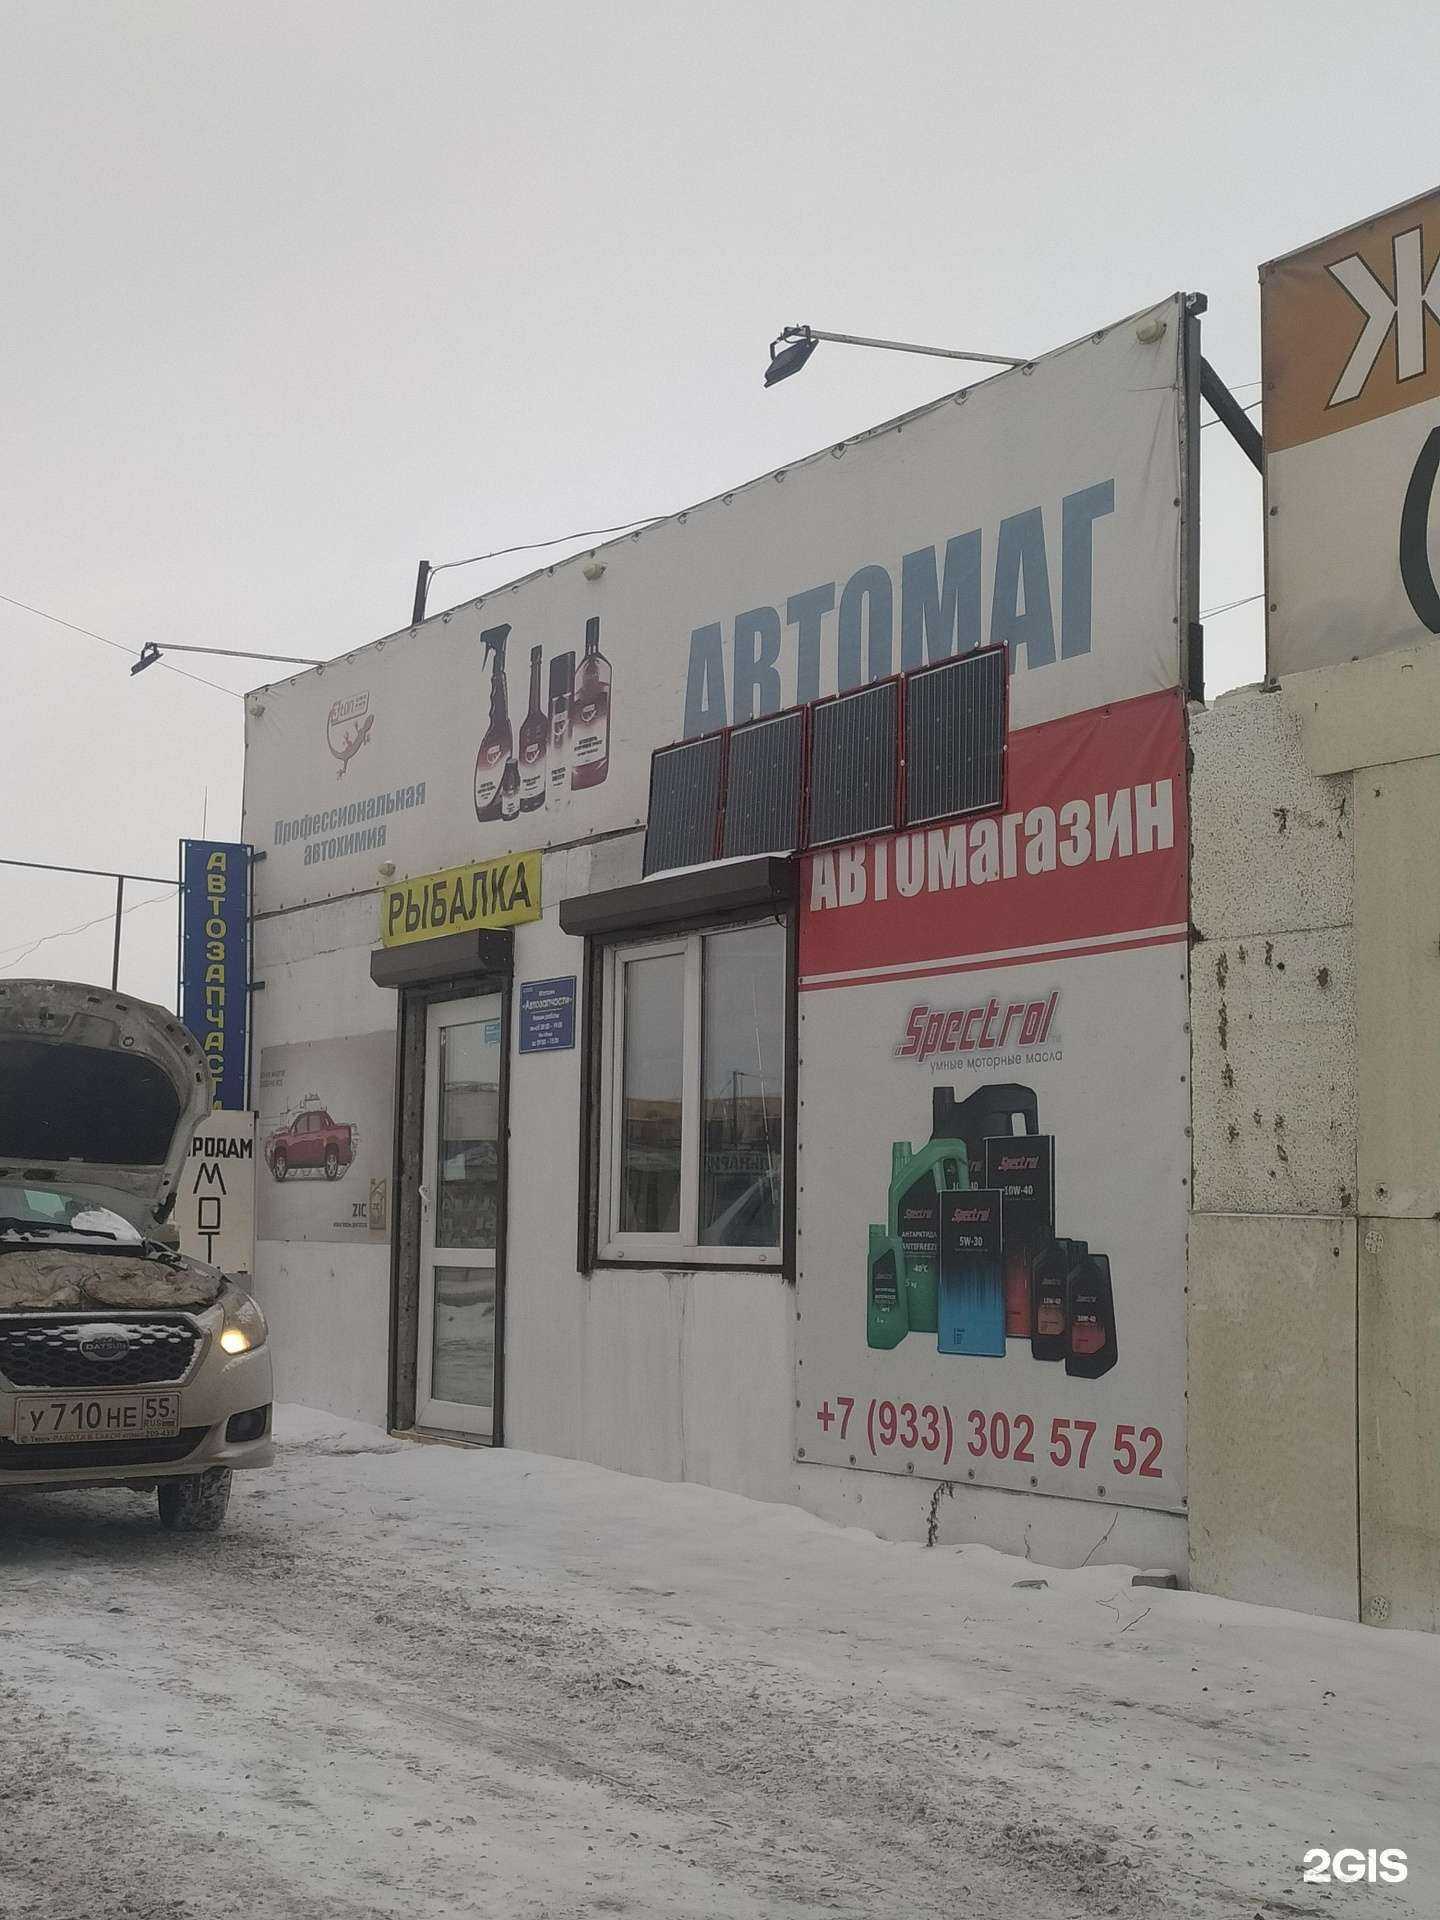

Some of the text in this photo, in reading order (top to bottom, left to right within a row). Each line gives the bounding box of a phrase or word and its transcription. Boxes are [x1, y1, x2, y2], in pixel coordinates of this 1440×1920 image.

[684, 478, 1115, 742] АВТОМАГ
[274, 782, 426, 846] Профессиональная
[304, 825, 387, 866] автохимия
[388, 861, 532, 937] РЫБАЛКА
[894, 990, 1060, 1063] Spectrol
[930, 1050, 1063, 1075] умные моторные масла
[187, 1136, 253, 1160] РОДАМ
[959, 1235, 983, 1247] 5W-30
[146, 1397, 170, 1419] 55
[816, 1396, 1164, 1479] +7 (933) 302 57 52
